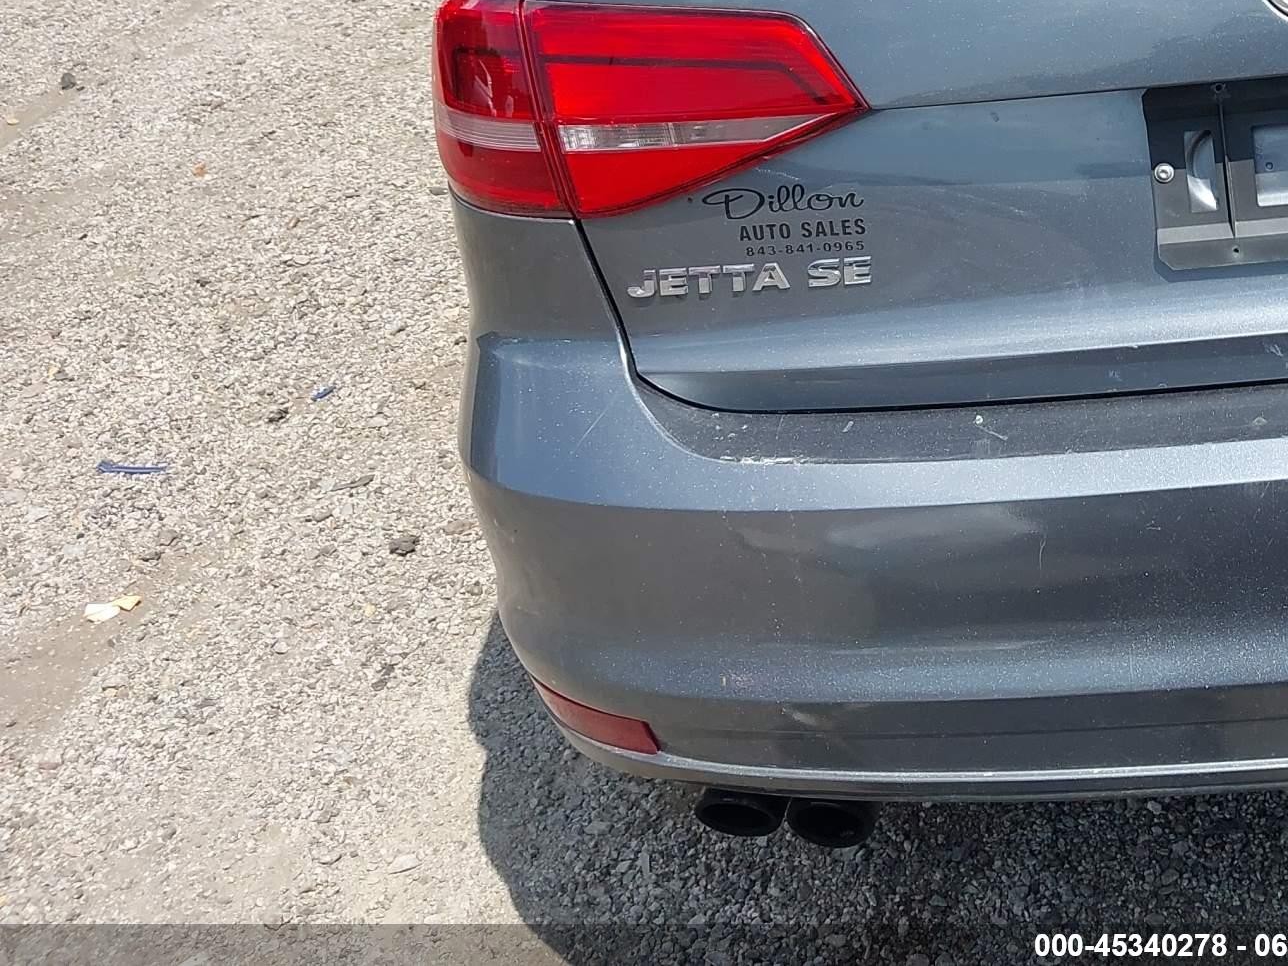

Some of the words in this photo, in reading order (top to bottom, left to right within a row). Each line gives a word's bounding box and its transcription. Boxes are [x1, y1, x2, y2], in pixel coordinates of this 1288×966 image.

[702, 183, 864, 220] Dillon
[739, 222, 791, 242] AUTO
[801, 218, 866, 236] SALES
[745, 240, 865, 257] 843-841-0965
[626, 262, 791, 299] JETTA
[807, 255, 872, 288] SE
